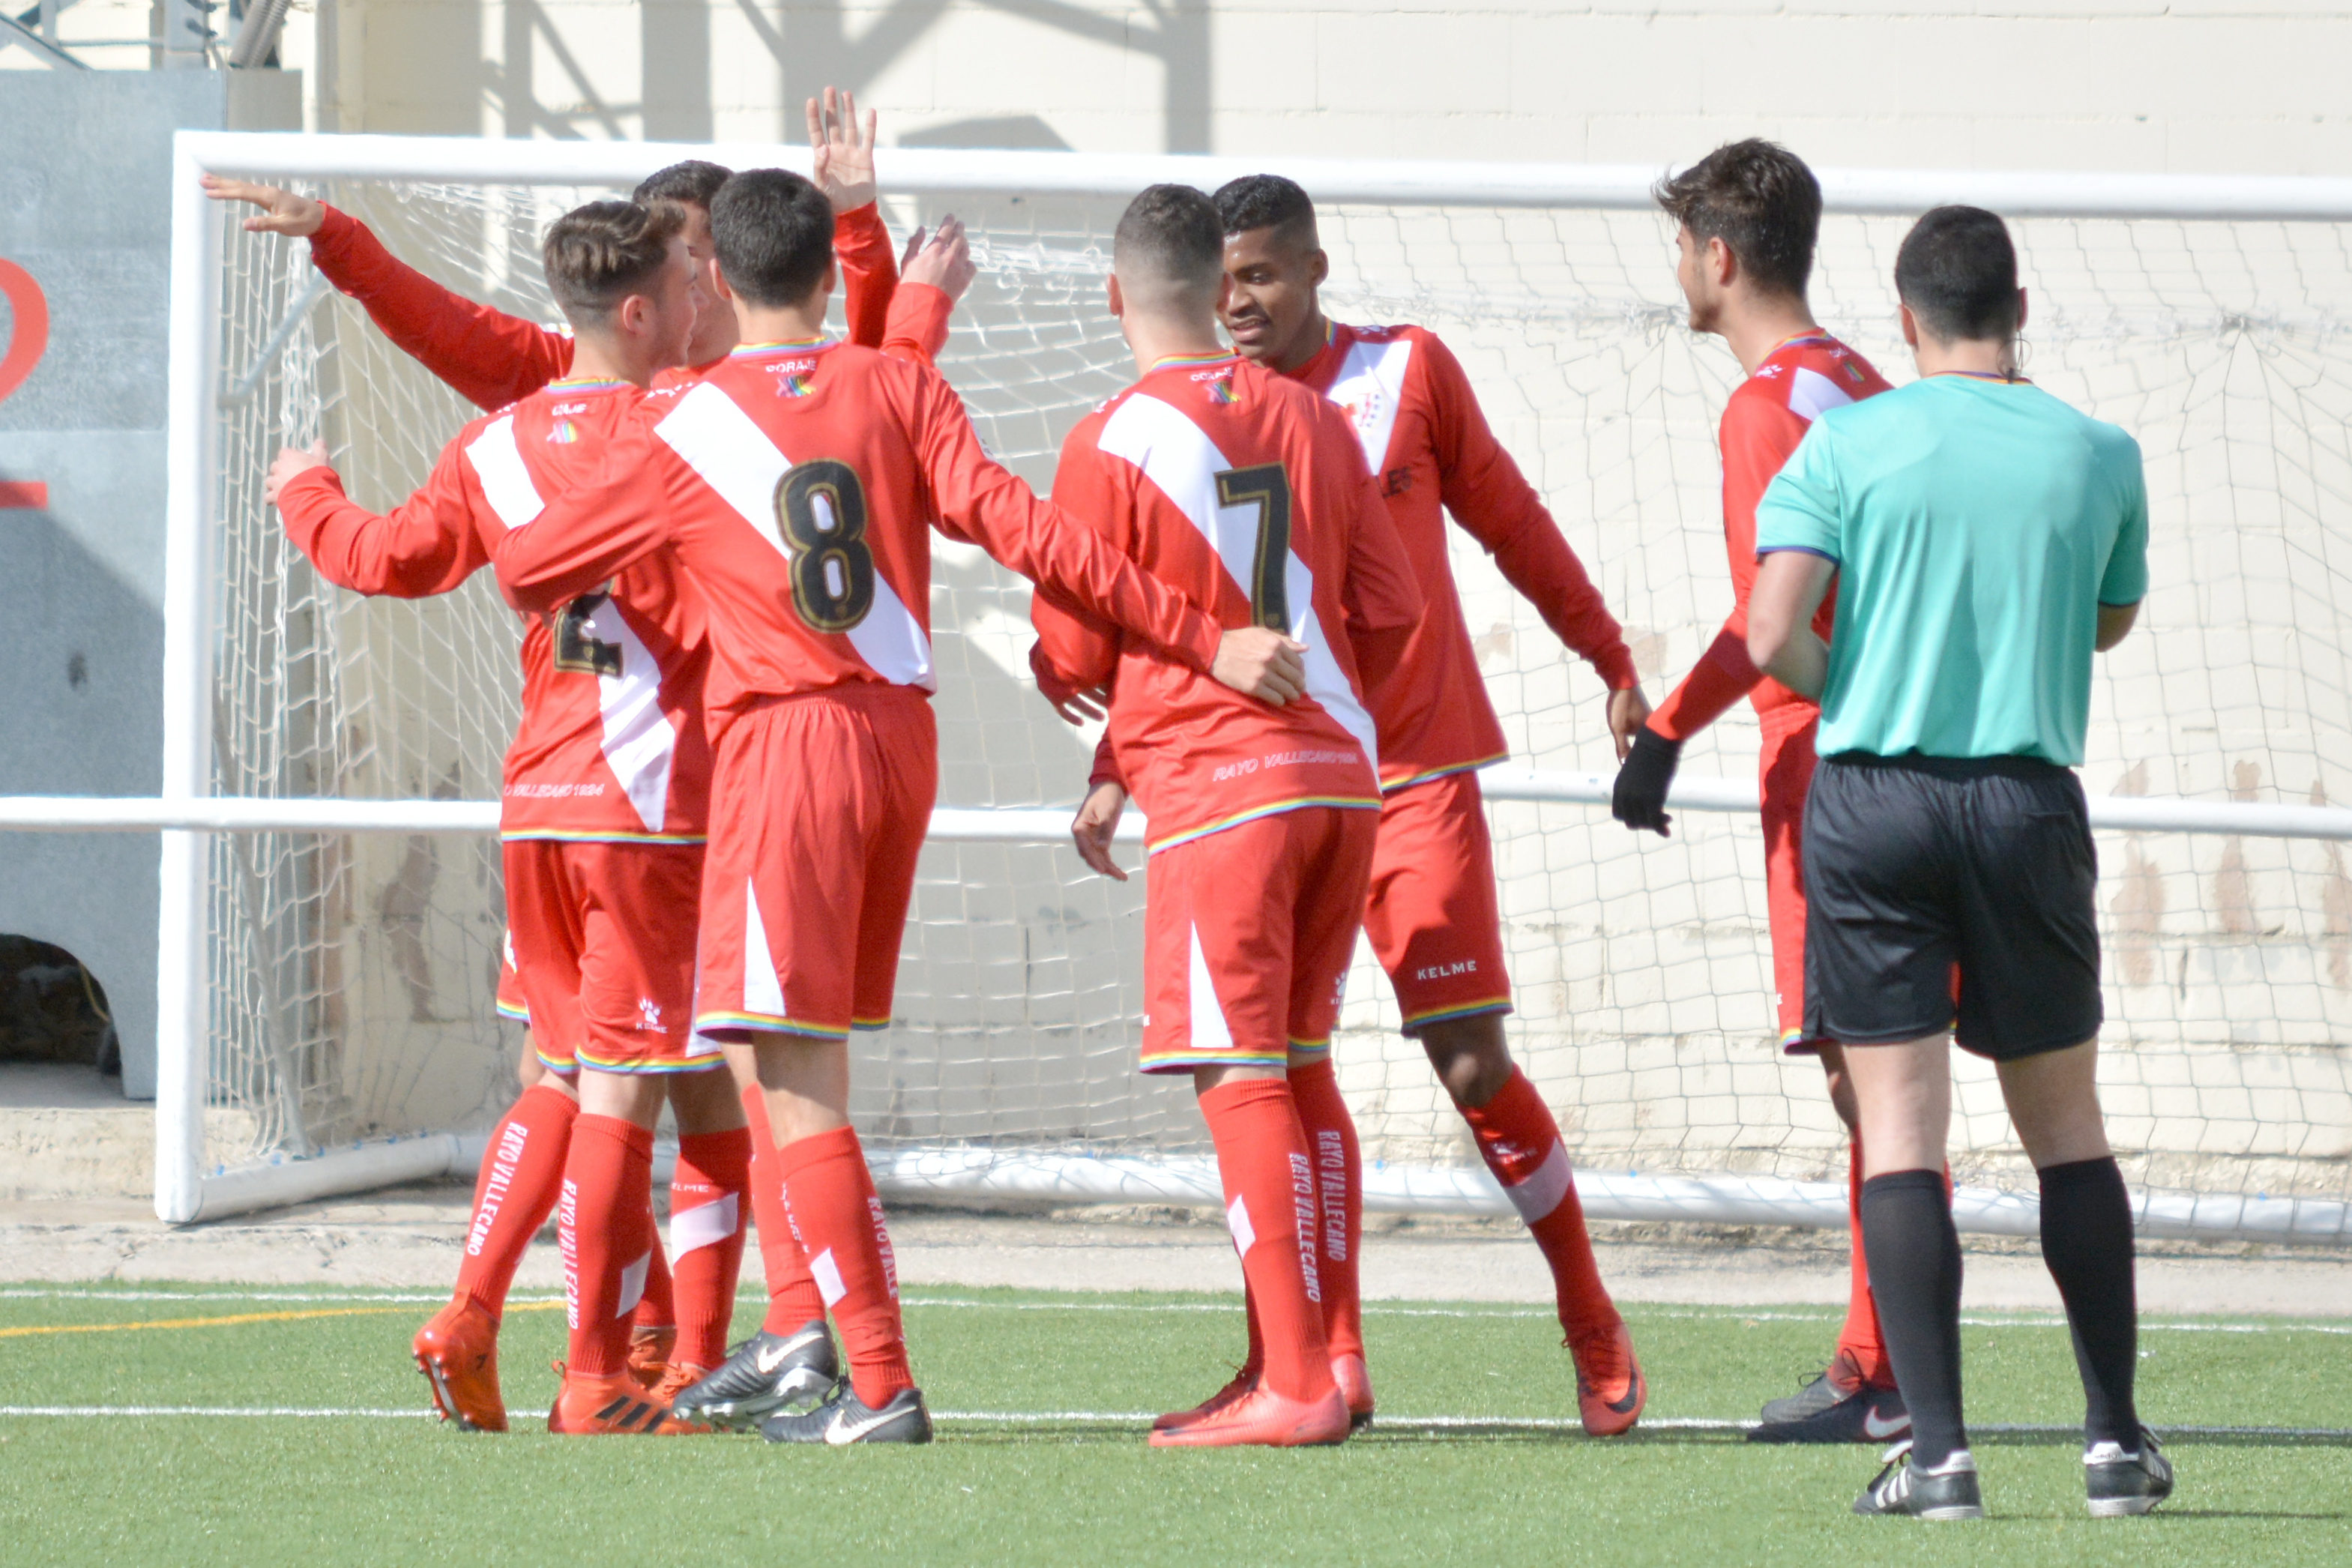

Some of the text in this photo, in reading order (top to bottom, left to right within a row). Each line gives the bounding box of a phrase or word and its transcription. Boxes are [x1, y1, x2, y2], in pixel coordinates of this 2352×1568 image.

[772, 457, 875, 634] 8
[1213, 460, 1293, 637] 7
[552, 574, 624, 680] 2
[1213, 758, 1258, 781] RAYO
[1417, 960, 1477, 980] KELME
[466, 1122, 529, 1256] RAYO VALLECANO
[559, 1179, 579, 1330] RAYO VALLECANO
[867, 1197, 890, 1243] RAYO
[1288, 1152, 1321, 1303] RAYO VALLECANO
[1318, 1130, 1346, 1261] RAYO VALLECANO
